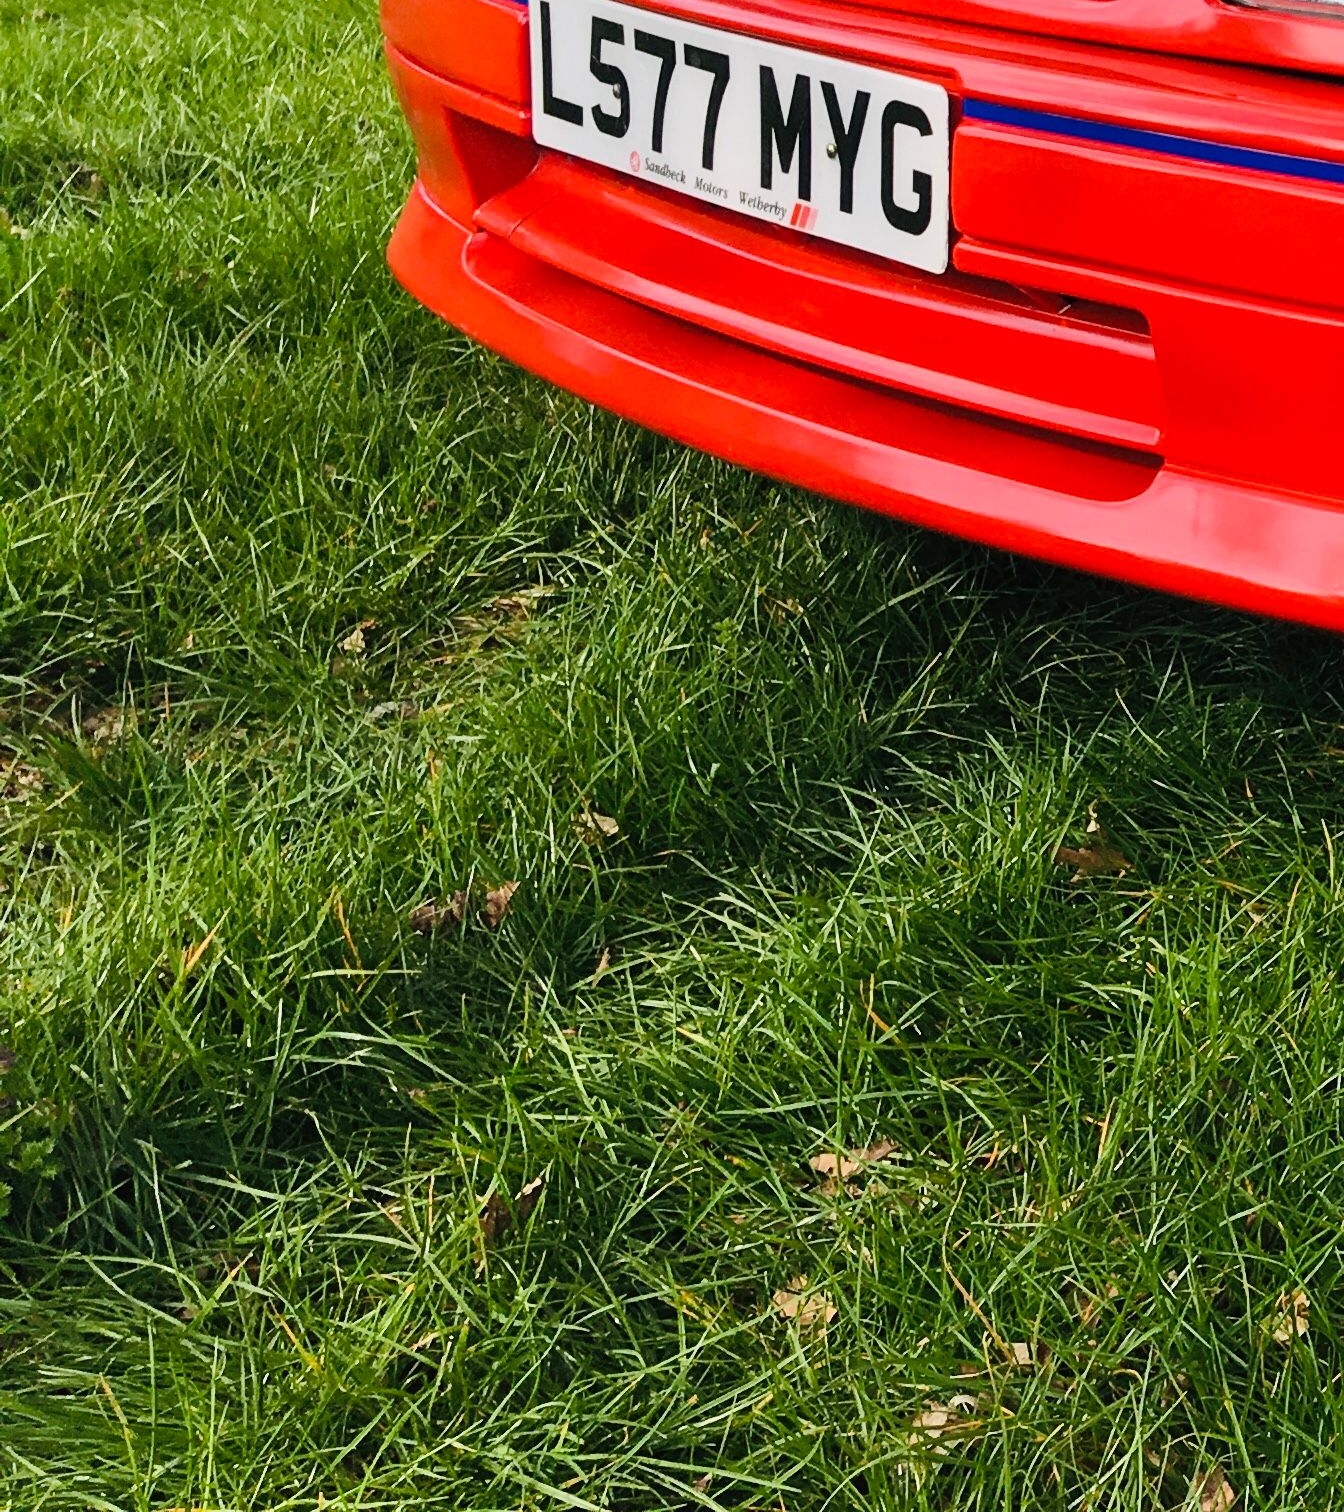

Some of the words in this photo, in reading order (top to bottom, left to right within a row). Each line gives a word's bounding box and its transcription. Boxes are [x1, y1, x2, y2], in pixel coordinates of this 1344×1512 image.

[540, 1, 730, 170] L577
[760, 65, 933, 237] MYG
[645, 157, 687, 185] Sandbeck
[695, 176, 729, 200] Motors
